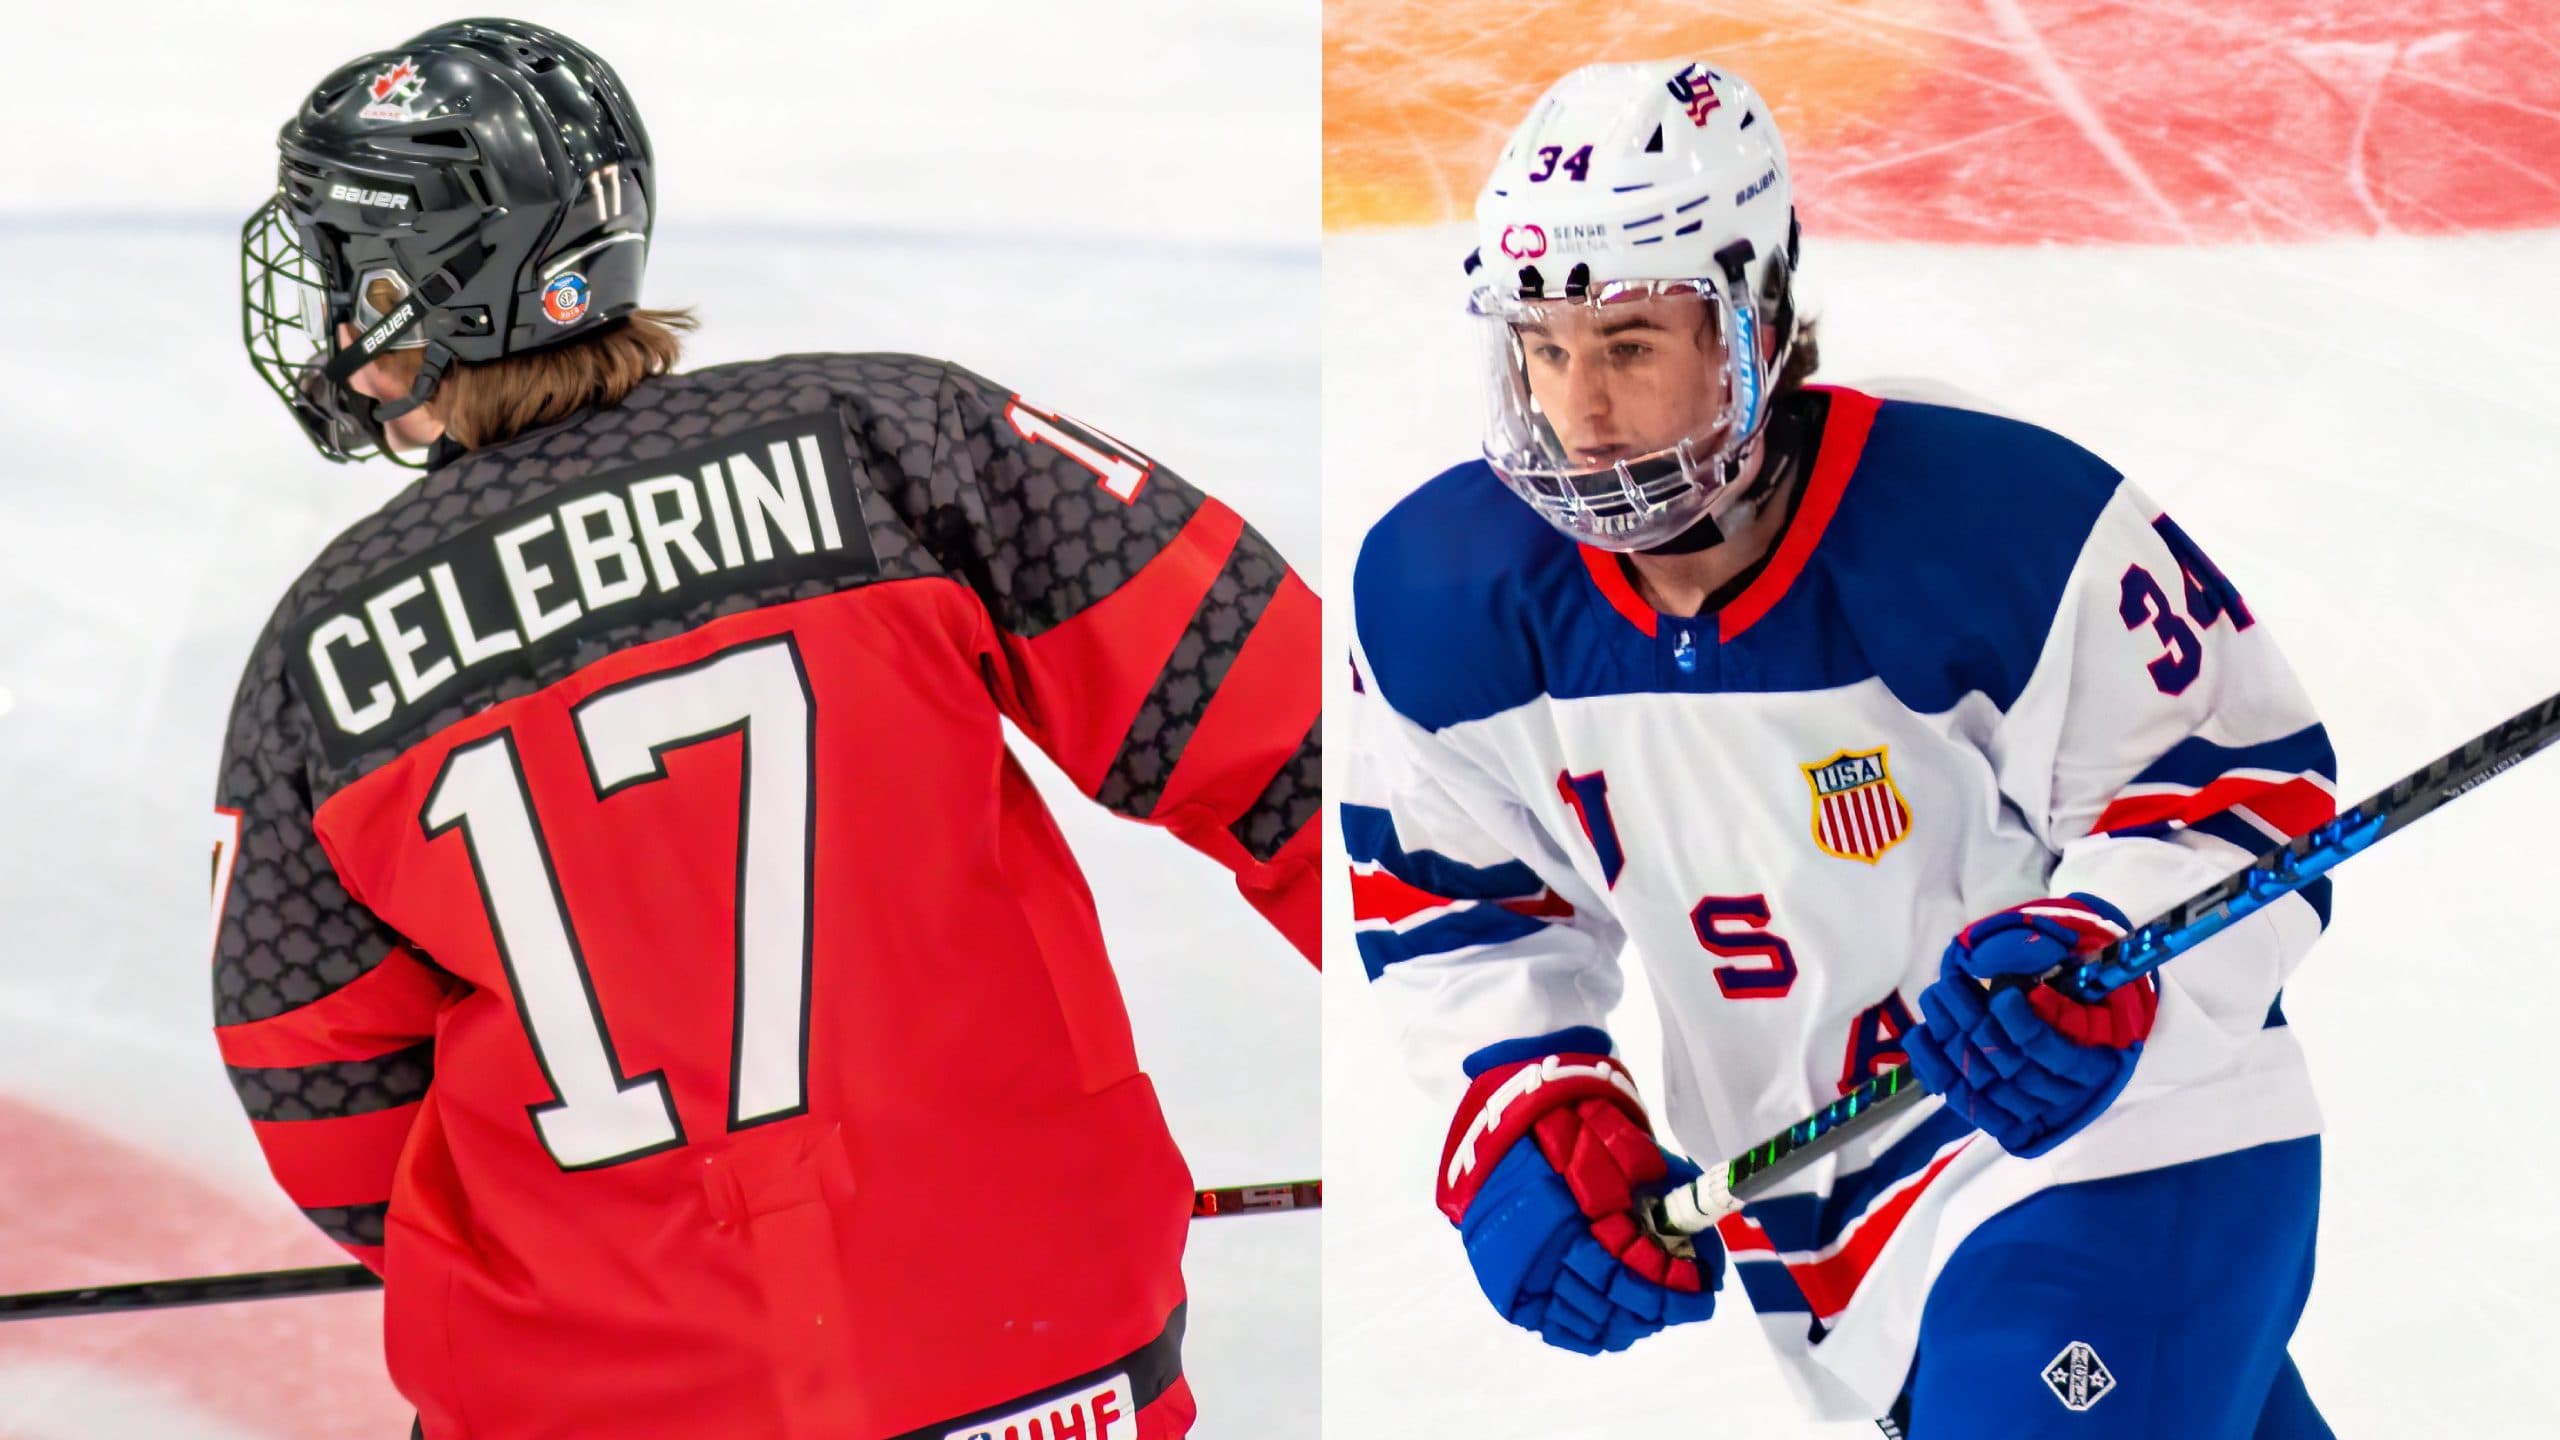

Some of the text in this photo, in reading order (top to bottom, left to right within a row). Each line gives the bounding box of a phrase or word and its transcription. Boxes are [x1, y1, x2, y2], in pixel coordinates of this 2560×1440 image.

[1528, 145, 1594, 182] 34
[1735, 168, 1776, 207] BAUER
[330, 184, 409, 210] BAUER
[590, 163, 622, 221] 17
[362, 303, 415, 353] BAUER
[308, 435, 843, 736] CELEBRINI
[2119, 512, 2256, 697] 34
[1823, 758, 1877, 791] USA
[417, 630, 817, 1172] 17
